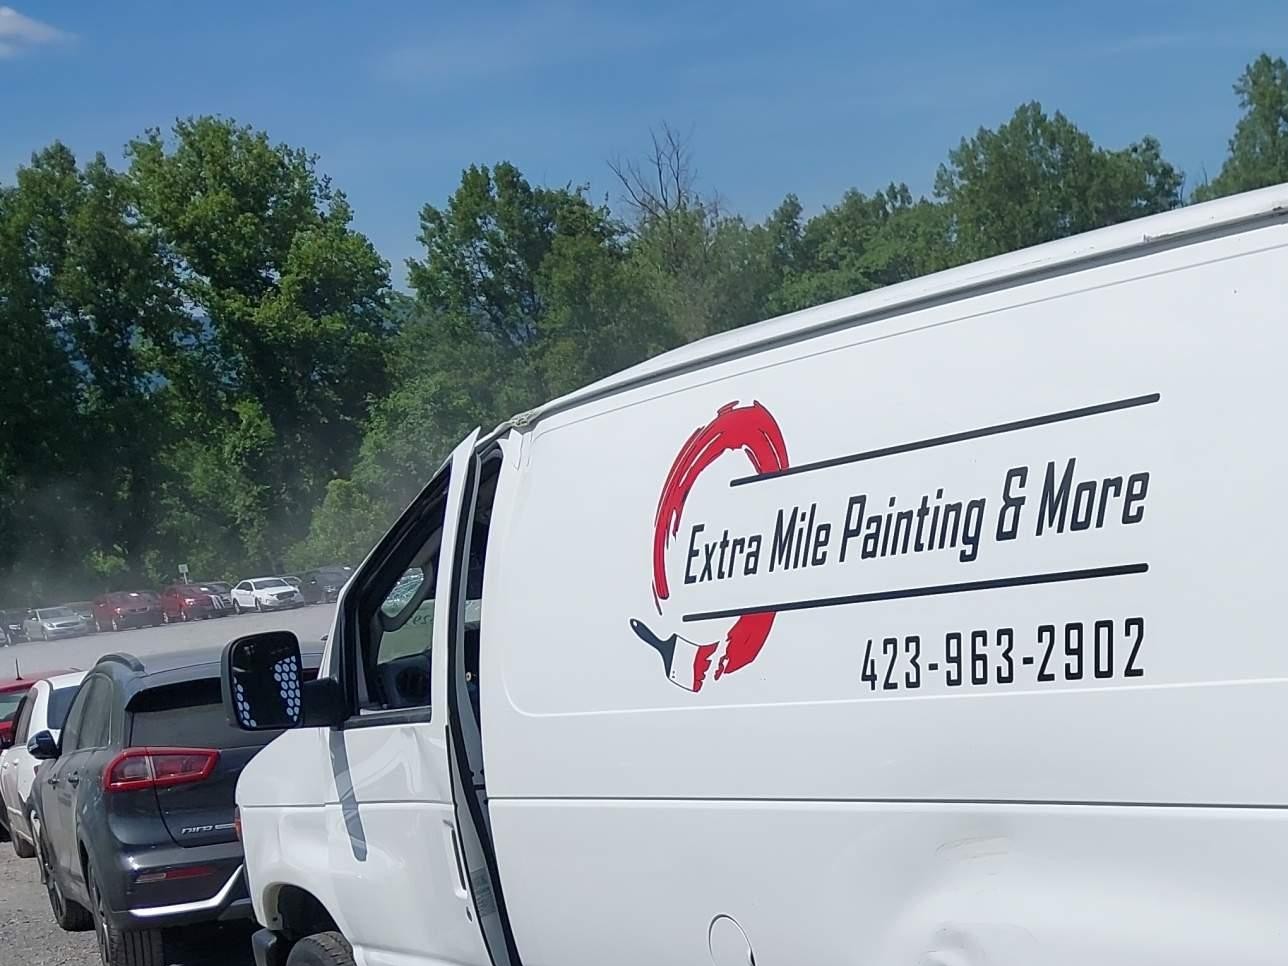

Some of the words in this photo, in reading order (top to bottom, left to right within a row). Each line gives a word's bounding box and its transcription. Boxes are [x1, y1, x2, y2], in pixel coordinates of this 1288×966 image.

[684, 524, 762, 584] Extra
[769, 503, 831, 573] Mile
[839, 489, 986, 562] Painting
[996, 466, 1028, 541] &
[1036, 458, 1150, 536] More
[861, 617, 1144, 690] 423-963-2902
